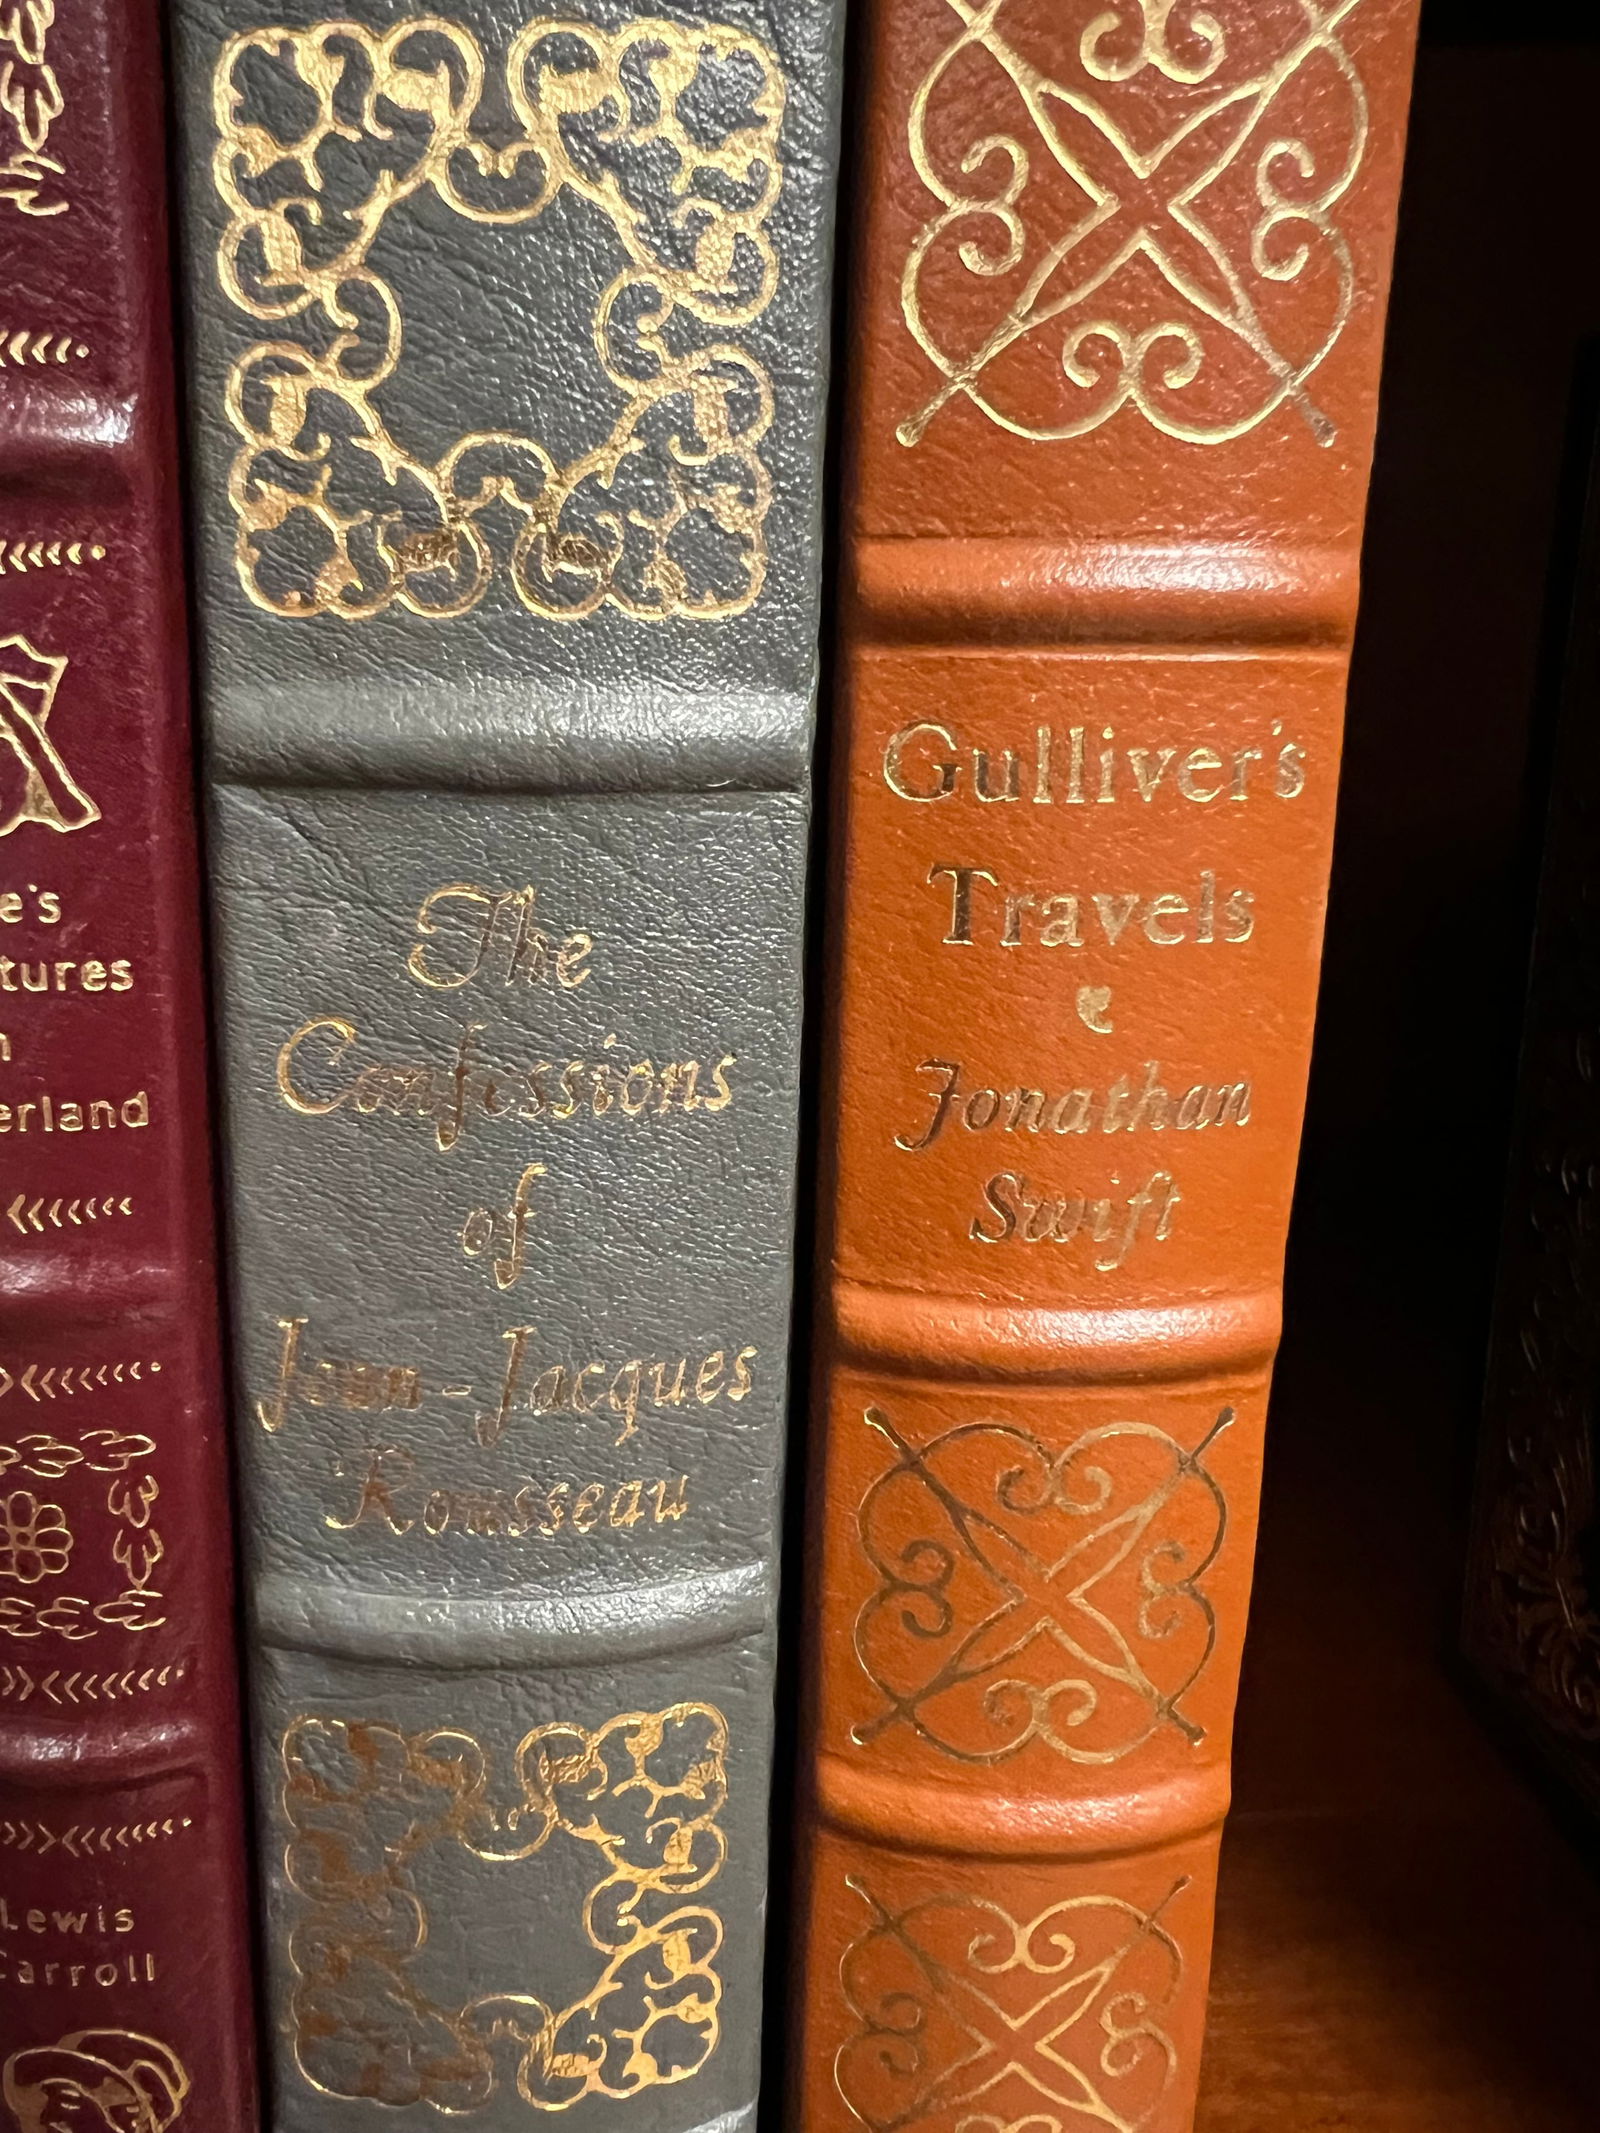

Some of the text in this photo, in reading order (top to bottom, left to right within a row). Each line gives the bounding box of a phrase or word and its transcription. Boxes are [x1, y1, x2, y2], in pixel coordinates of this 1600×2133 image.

[883, 719, 1306, 803] Gulliver's
[408, 883, 594, 989] The
[927, 864, 1254, 947] Travels
[277, 1016, 738, 1152] Confessions
[894, 1057, 1252, 1151] Jonathan
[460, 1161, 550, 1290] of
[969, 1169, 1181, 1271] Swift
[324, 1443, 690, 1537] Rousseau
[0, 1897, 134, 1934] Lewis
[0, 1951, 155, 1987] arroll
